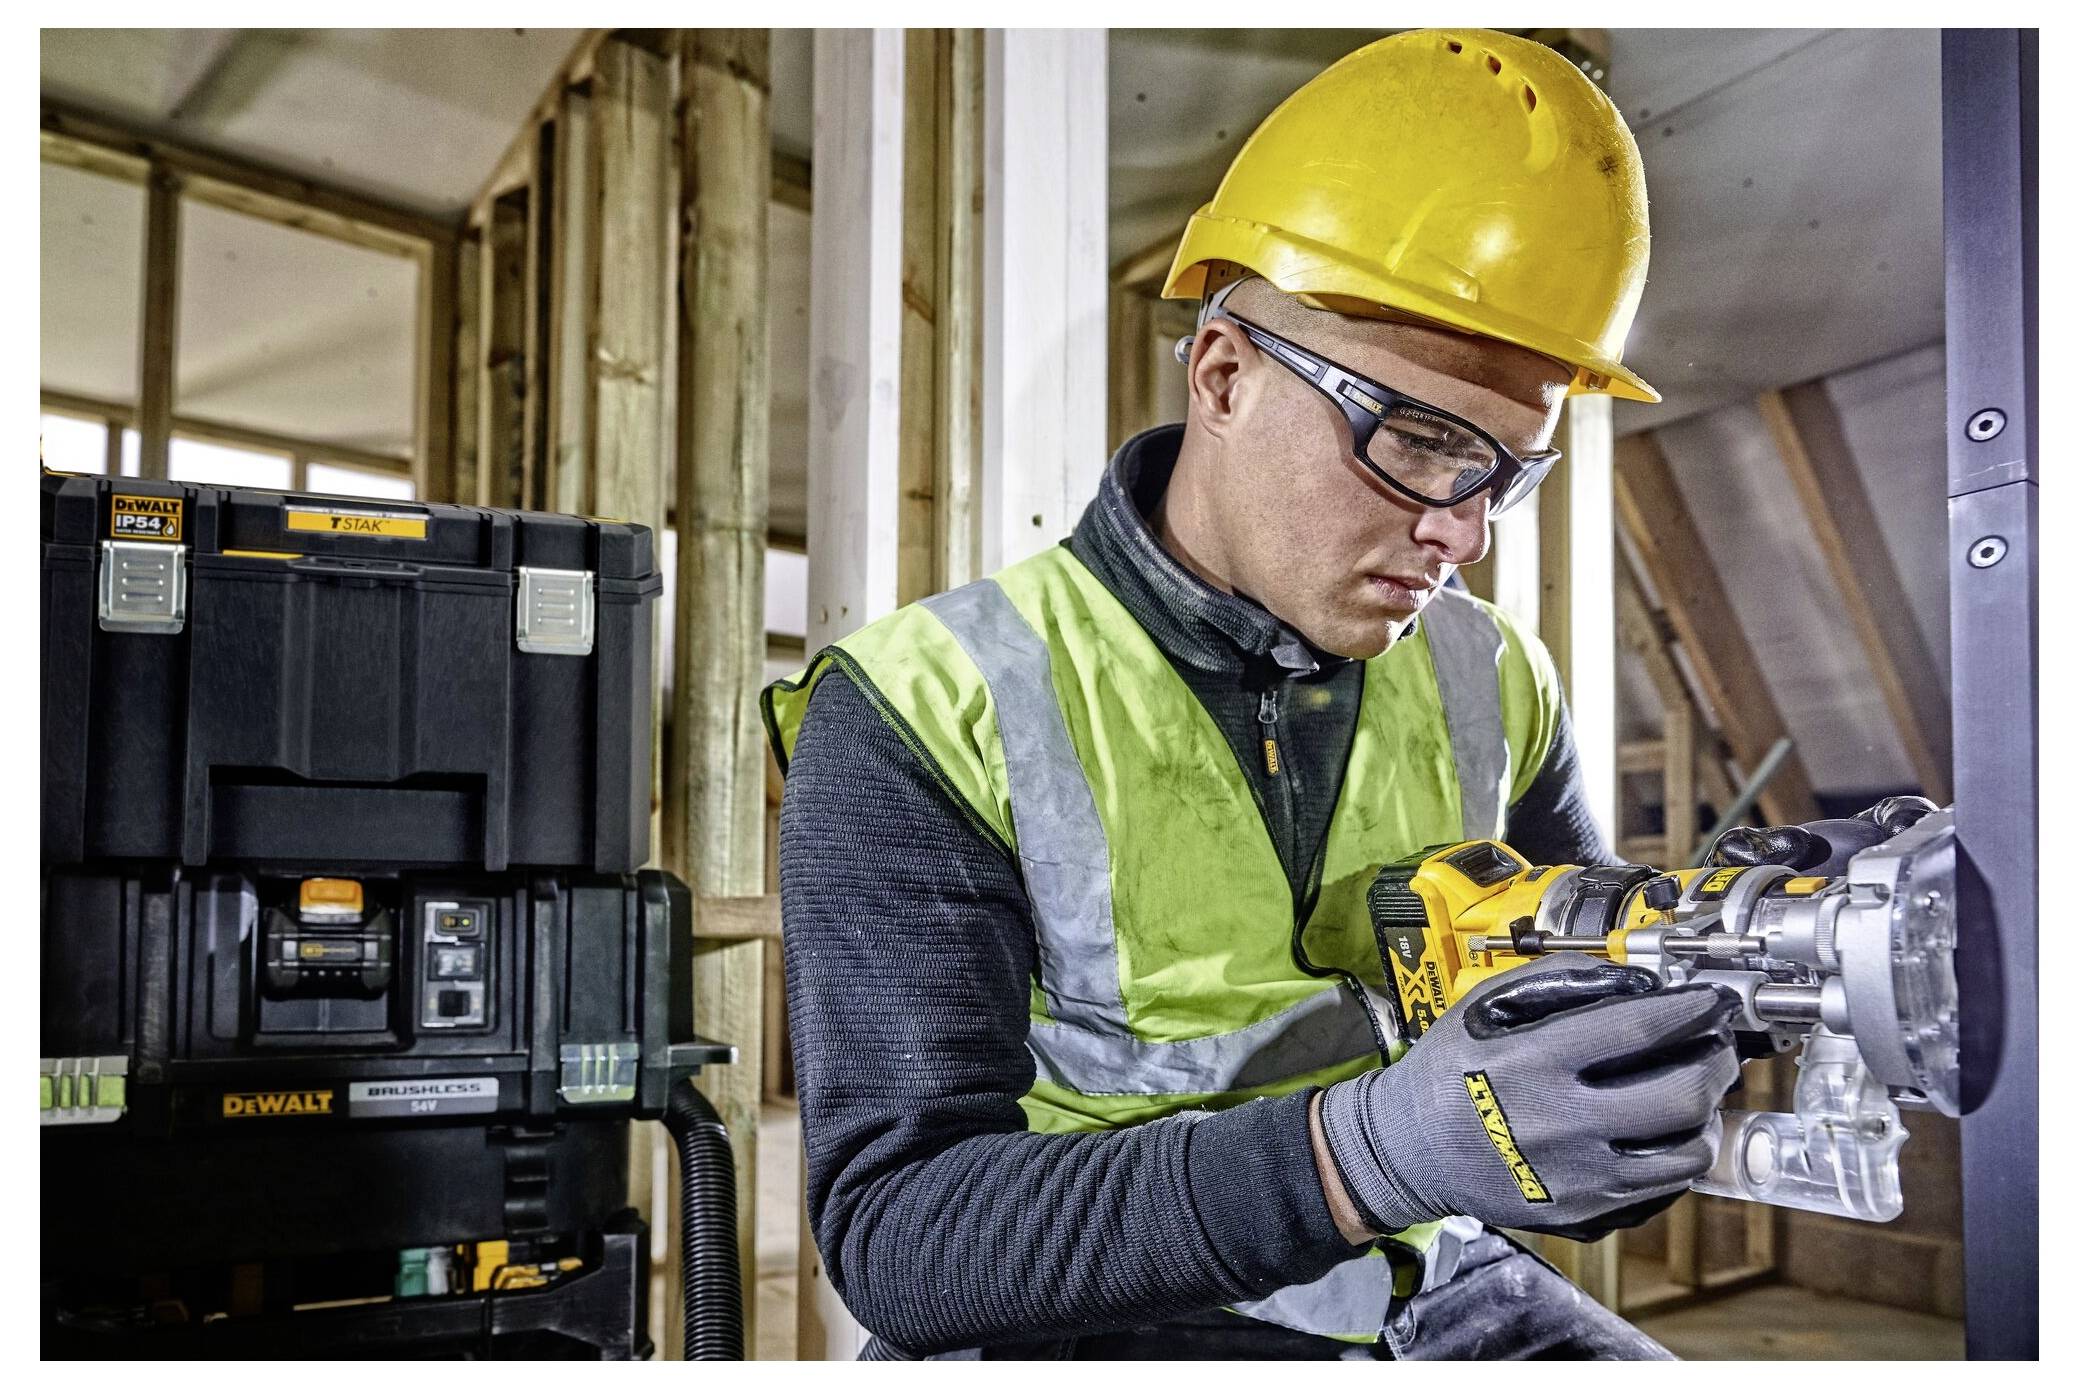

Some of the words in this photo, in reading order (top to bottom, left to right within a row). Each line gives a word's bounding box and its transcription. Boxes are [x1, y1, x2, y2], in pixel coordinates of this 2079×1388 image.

[115, 499, 179, 513] DEWALT
[116, 514, 161, 530] IP54
[1702, 867, 1744, 892] DEW
[1398, 936, 1413, 959] 18V
[1425, 961, 1447, 1011] DEWALT
[367, 1083, 482, 1097] BRUSHLESS
[223, 1092, 333, 1115] DEWALT
[411, 1100, 439, 1113] 54V
[1465, 1074, 1548, 1199] DEWALT
